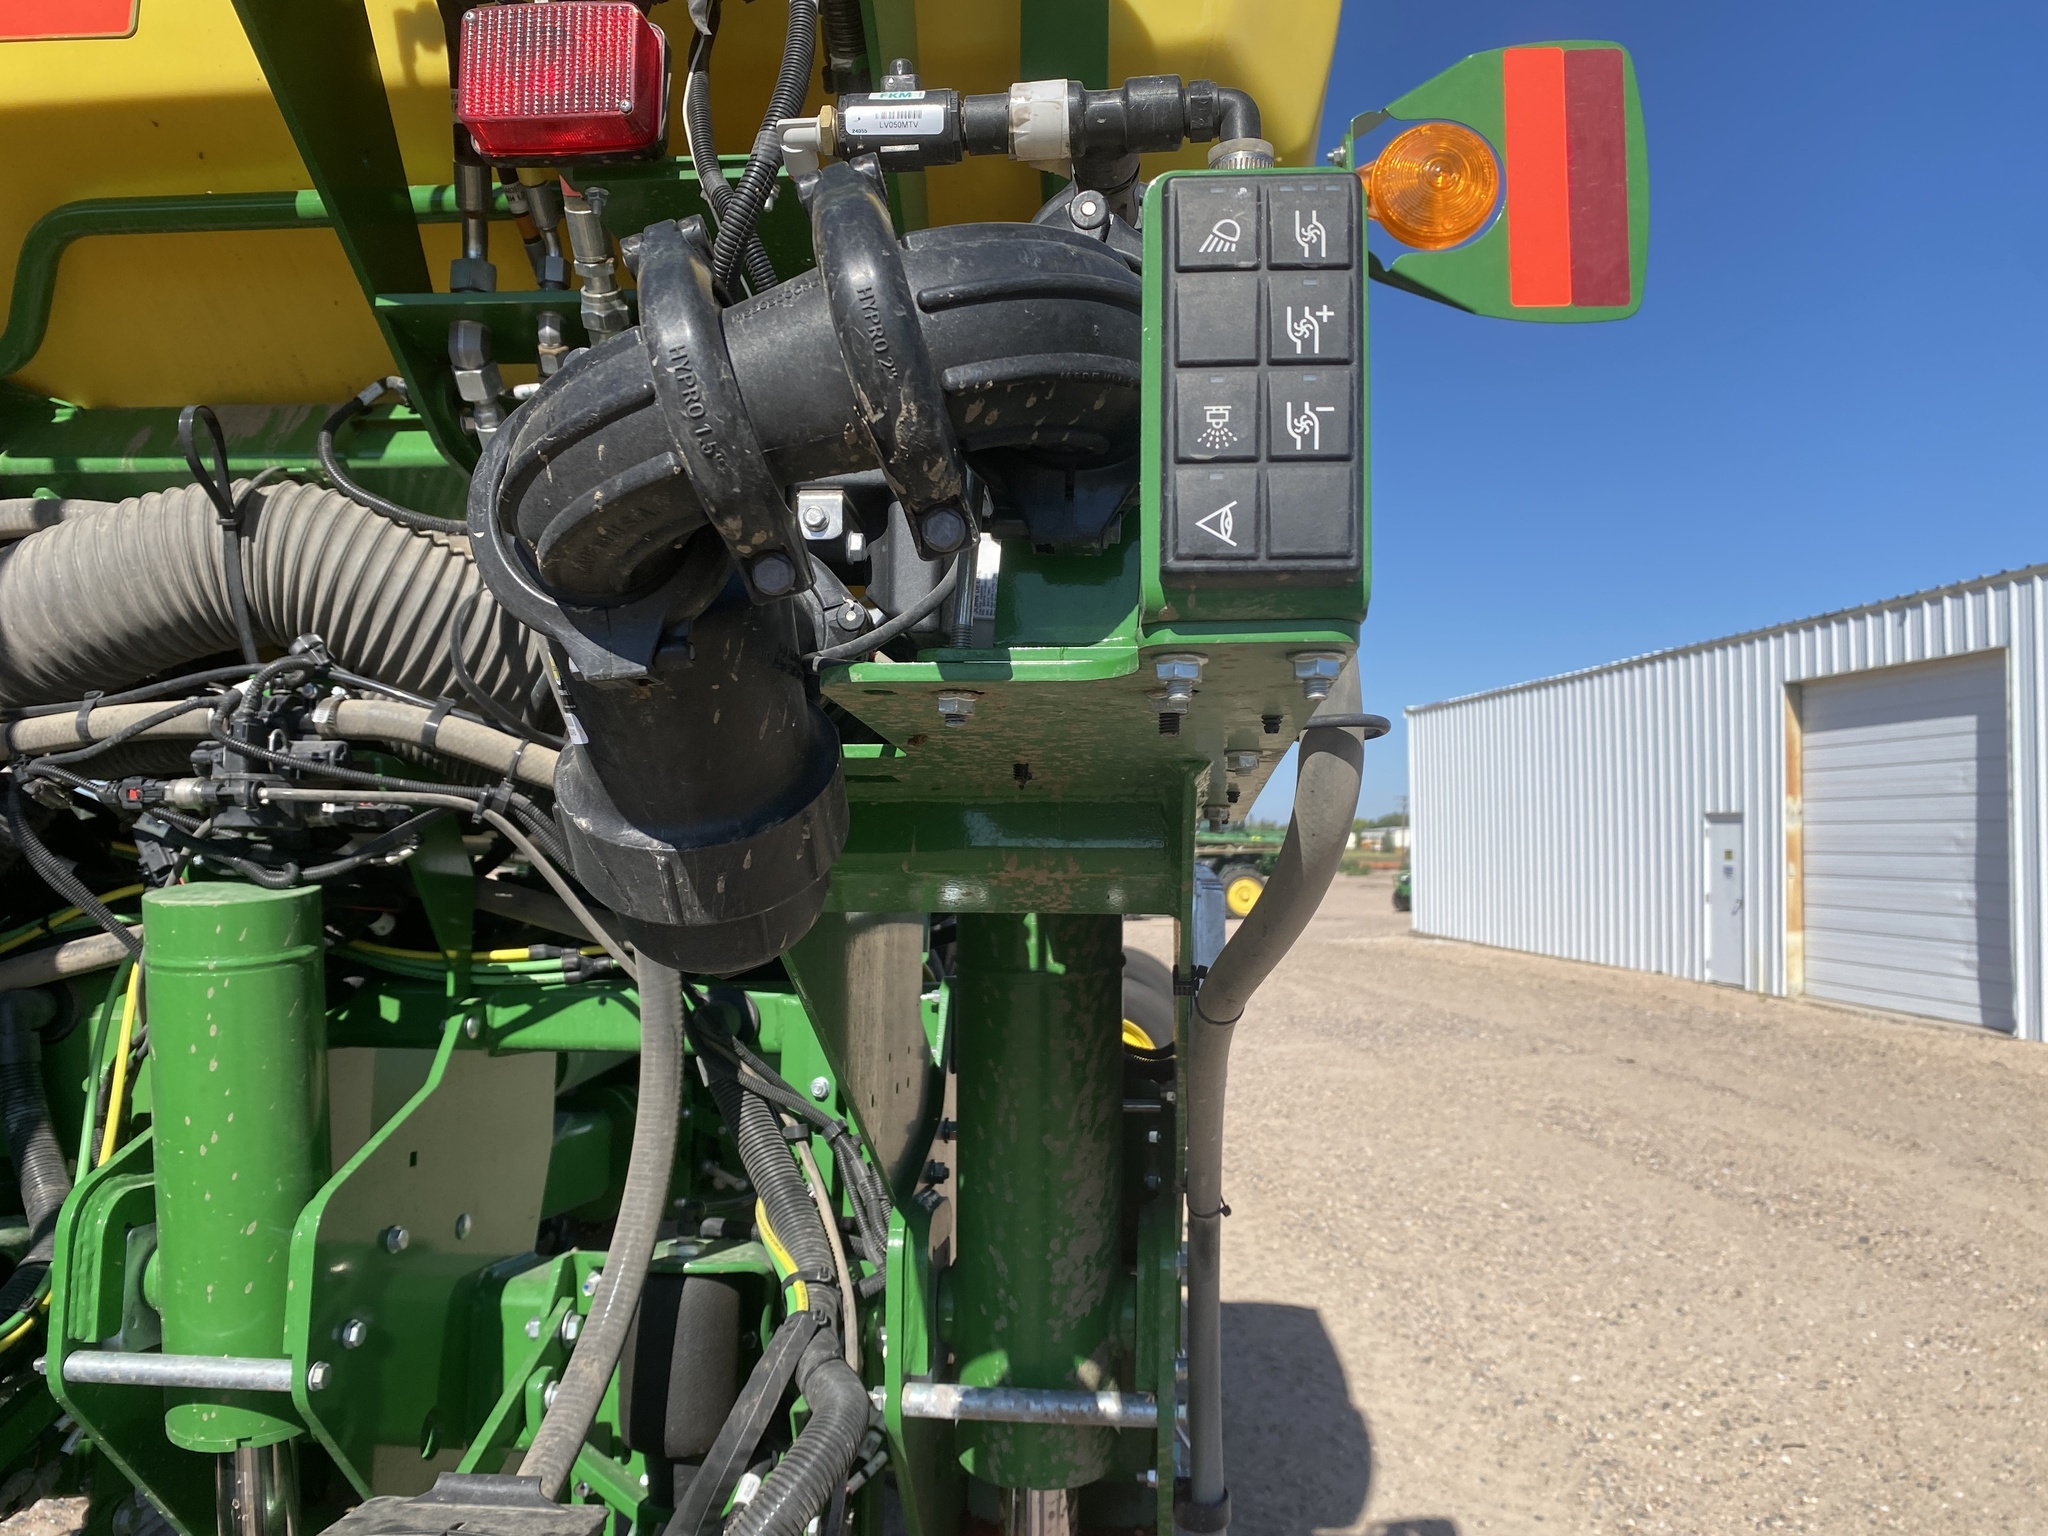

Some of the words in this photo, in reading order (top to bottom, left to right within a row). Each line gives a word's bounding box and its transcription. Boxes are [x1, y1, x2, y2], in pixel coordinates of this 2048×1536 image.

[879, 121, 919, 129] LV050MTV
[857, 287, 888, 353] HYPRO
[669, 344, 705, 420] HYPRO
